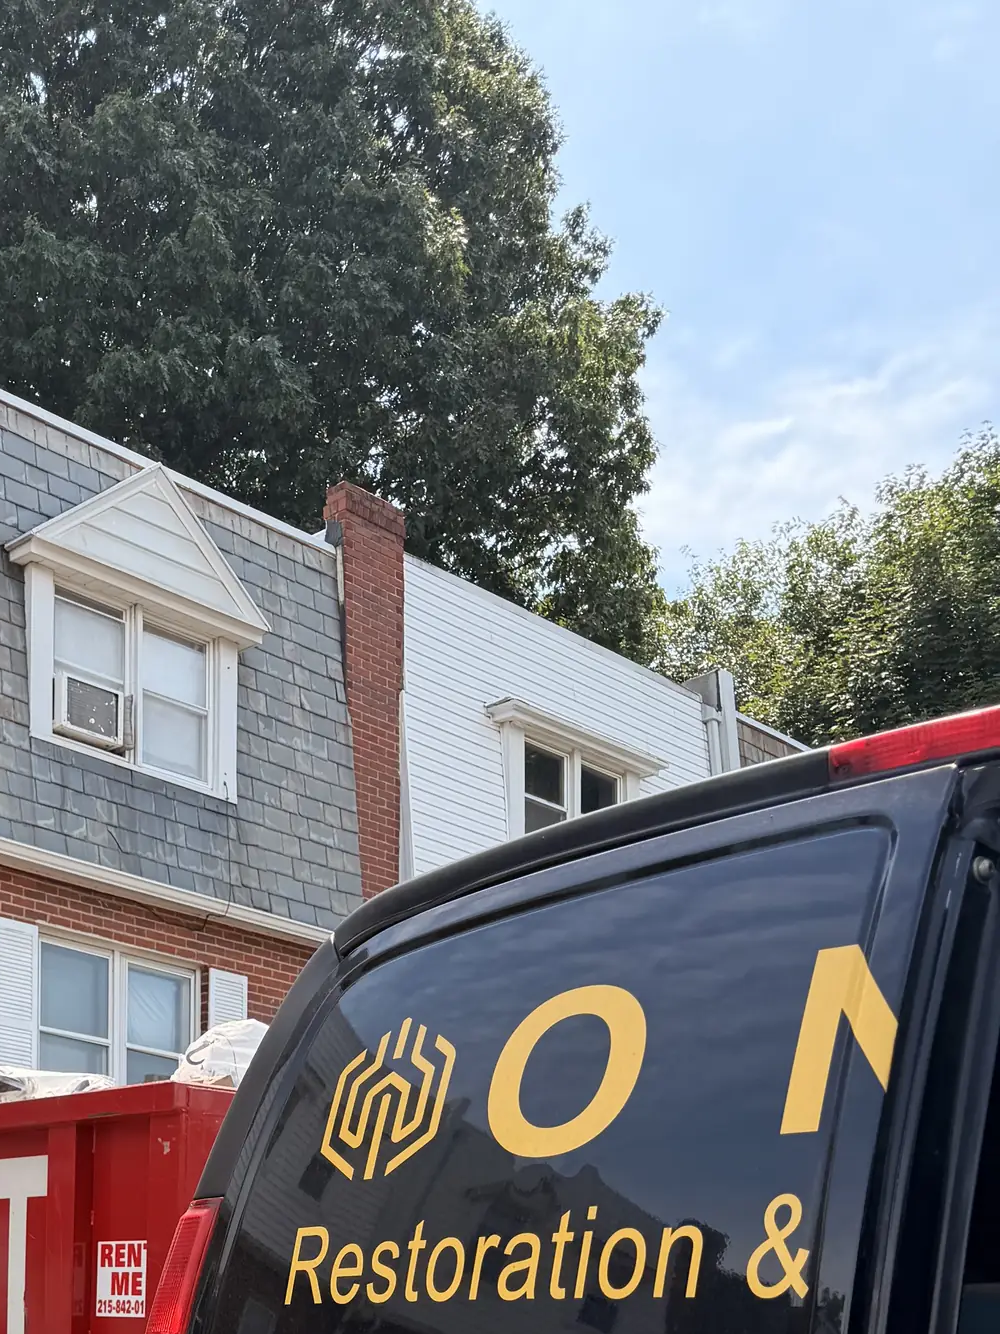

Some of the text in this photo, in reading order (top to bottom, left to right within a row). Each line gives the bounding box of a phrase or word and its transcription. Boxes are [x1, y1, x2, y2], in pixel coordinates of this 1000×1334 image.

[284, 1193, 811, 1306] Restoration &
[110, 1272, 143, 1296] ME
